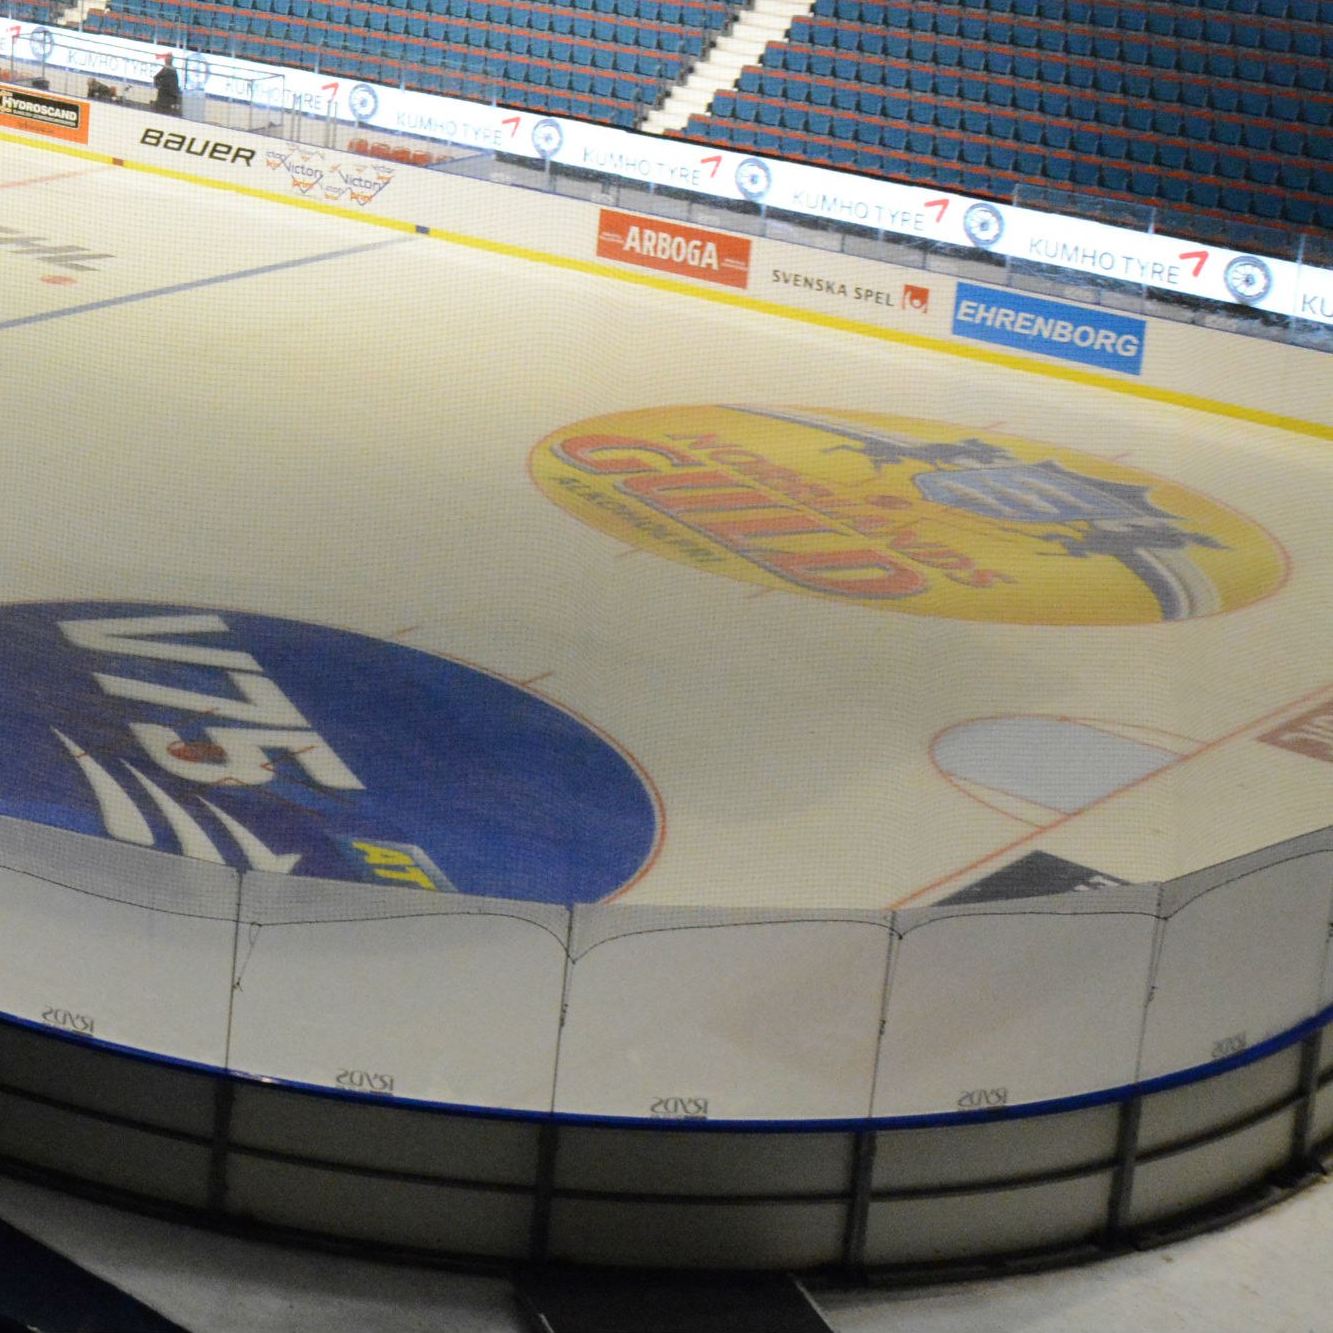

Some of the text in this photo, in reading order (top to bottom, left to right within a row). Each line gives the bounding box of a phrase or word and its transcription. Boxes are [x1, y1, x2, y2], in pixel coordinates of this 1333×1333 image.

[2, 94, 77, 121] HYDROSCAND
[288, 91, 322, 111] TYRE
[140, 128, 256, 167] BAUER
[397, 112, 501, 146] KUMHO TYRE
[583, 146, 701, 187] KUMHO TYRE
[792, 189, 925, 232] KUMHO TYRE
[622, 225, 719, 271] ARBOGA
[1030, 237, 1181, 285] KUMHO TYRE
[772, 269, 894, 307] SVENSKA SPEL
[956, 299, 1139, 358] EHRENBORG
[549, 432, 930, 598] GULD
[57, 614, 367, 791] V75
[352, 841, 436, 890] AT
